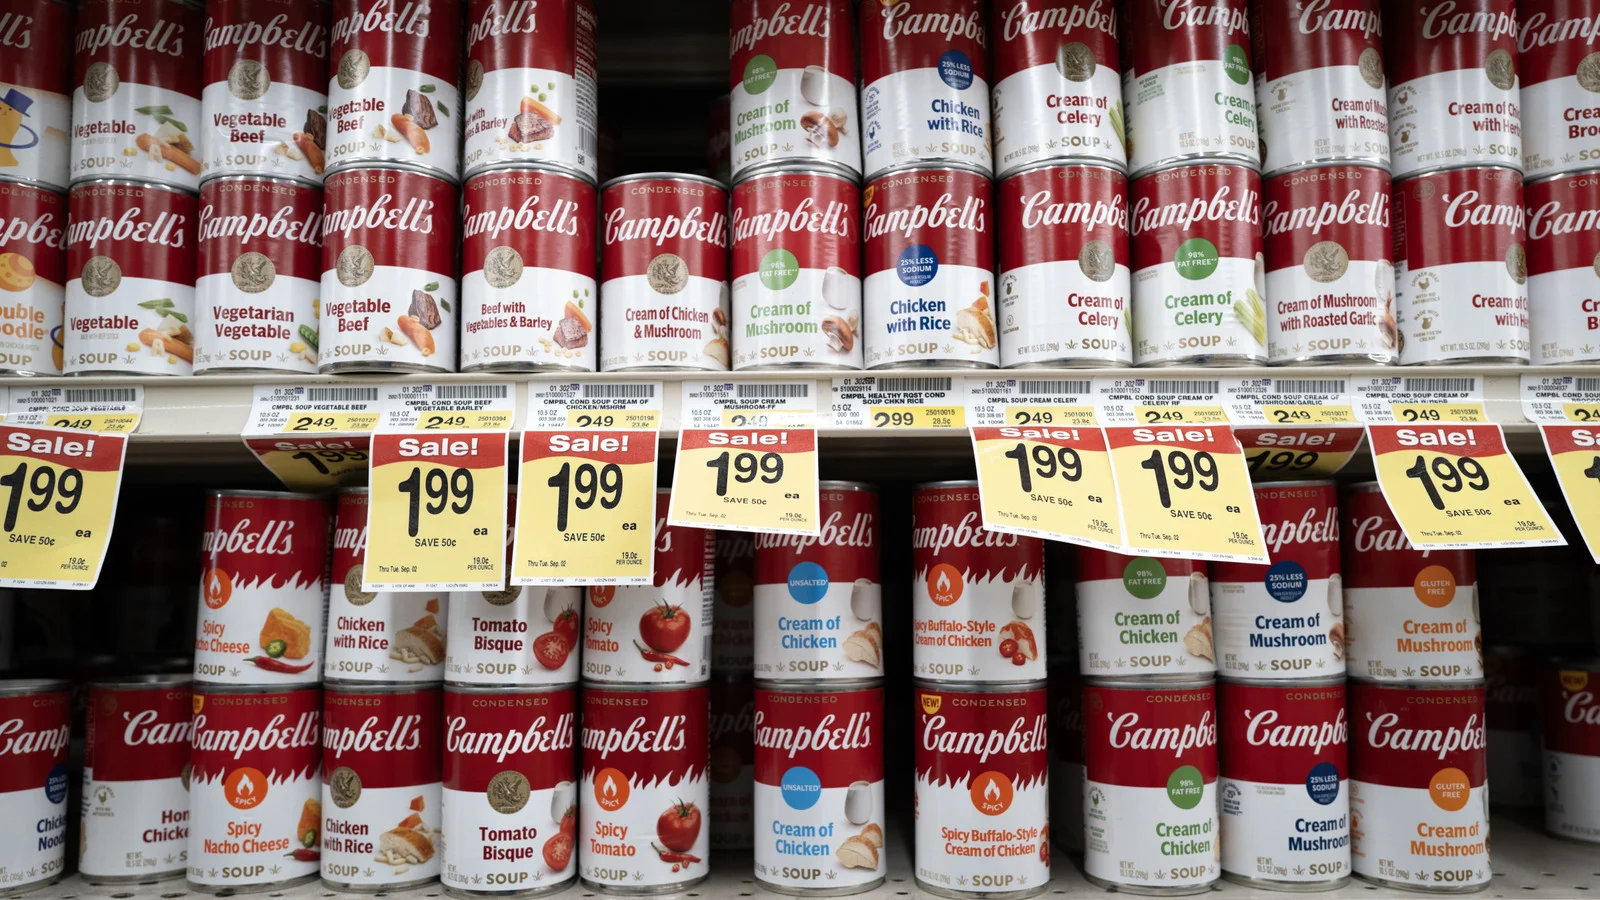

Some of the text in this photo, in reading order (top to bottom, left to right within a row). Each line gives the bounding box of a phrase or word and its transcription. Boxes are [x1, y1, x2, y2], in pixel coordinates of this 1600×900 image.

[1046, 94, 1107, 108] Cream of
[932, 99, 980, 120] Chicken
[213, 113, 286, 128] Vegetable
[1057, 110, 1101, 127] Celery
[74, 121, 136, 138] Vegetable
[927, 117, 983, 138] with Rice
[230, 129, 265, 143] Beef
[226, 154, 267, 166] SOUP
[220, 184, 296, 196] CONDENSED
[632, 186, 704, 197] CONDENSED
[901, 258, 933, 266] 25% LESS
[1188, 251, 1204, 259] 98%
[902, 264, 932, 274] SODIUM
[1177, 260, 1190, 268] FAT
[482, 302, 526, 314] Beef with
[890, 298, 946, 315] Chicken
[1278, 294, 1377, 314] Cream of Mushroom
[213, 306, 294, 322] Vegetarian
[626, 306, 708, 324] Cream of Chicken
[70, 315, 138, 332] Vegetable
[510, 317, 517, 328] &
[519, 316, 552, 331] Barley
[887, 316, 950, 334] with Rice
[1280, 312, 1376, 332] with Roasted Garlic
[215, 324, 290, 340] Vegetable
[634, 324, 702, 340] & Mushroom
[79, 353, 118, 364] SOUP
[874, 412, 914, 427] 299
[1403, 409, 1440, 422] 249
[293, 417, 335, 430] 249
[7, 432, 95, 458] Sale!
[549, 434, 629, 452] Sale!
[708, 432, 788, 445] Sale!
[1256, 432, 1336, 446] Sale!
[1396, 429, 1476, 446] Sale!
[707, 451, 784, 496] 199
[1005, 442, 1083, 493] 199
[1406, 455, 1490, 511] 199
[0, 462, 83, 532] 199
[398, 466, 474, 538] 199
[1504, 498, 1521, 506] ea
[1446, 509, 1473, 517] SAVE
[76, 529, 91, 538] ea
[414, 538, 440, 547] SAVE
[1136, 570, 1153, 578] 98%
[1269, 573, 1303, 582] 25% LESS
[1128, 578, 1141, 586] FAT
[1272, 581, 1302, 589] SODIUM
[472, 617, 527, 633] Tomato
[1115, 610, 1180, 626] Cream of
[203, 620, 225, 634] Spicy
[474, 636, 523, 653] Bisque
[1119, 630, 1178, 645] Chicken
[210, 639, 250, 654] Cheese
[922, 697, 940, 708] NEW!
[952, 698, 1027, 707] CONDENSED
[446, 712, 574, 763] Campbell's
[234, 795, 256, 806] SPICY
[227, 821, 262, 838] Spicy
[595, 821, 628, 840] Spicy
[942, 826, 1038, 843] Spicy Buffalo-Style
[1416, 821, 1479, 839] Cream of
[204, 838, 289, 854] Nacho Cheese
[591, 838, 636, 857] Tomato
[945, 843, 1036, 858] Cream of Chicken
[1410, 841, 1484, 858] Mushroom
[782, 867, 821, 880] SOUP
[1433, 870, 1473, 882] SOUP
